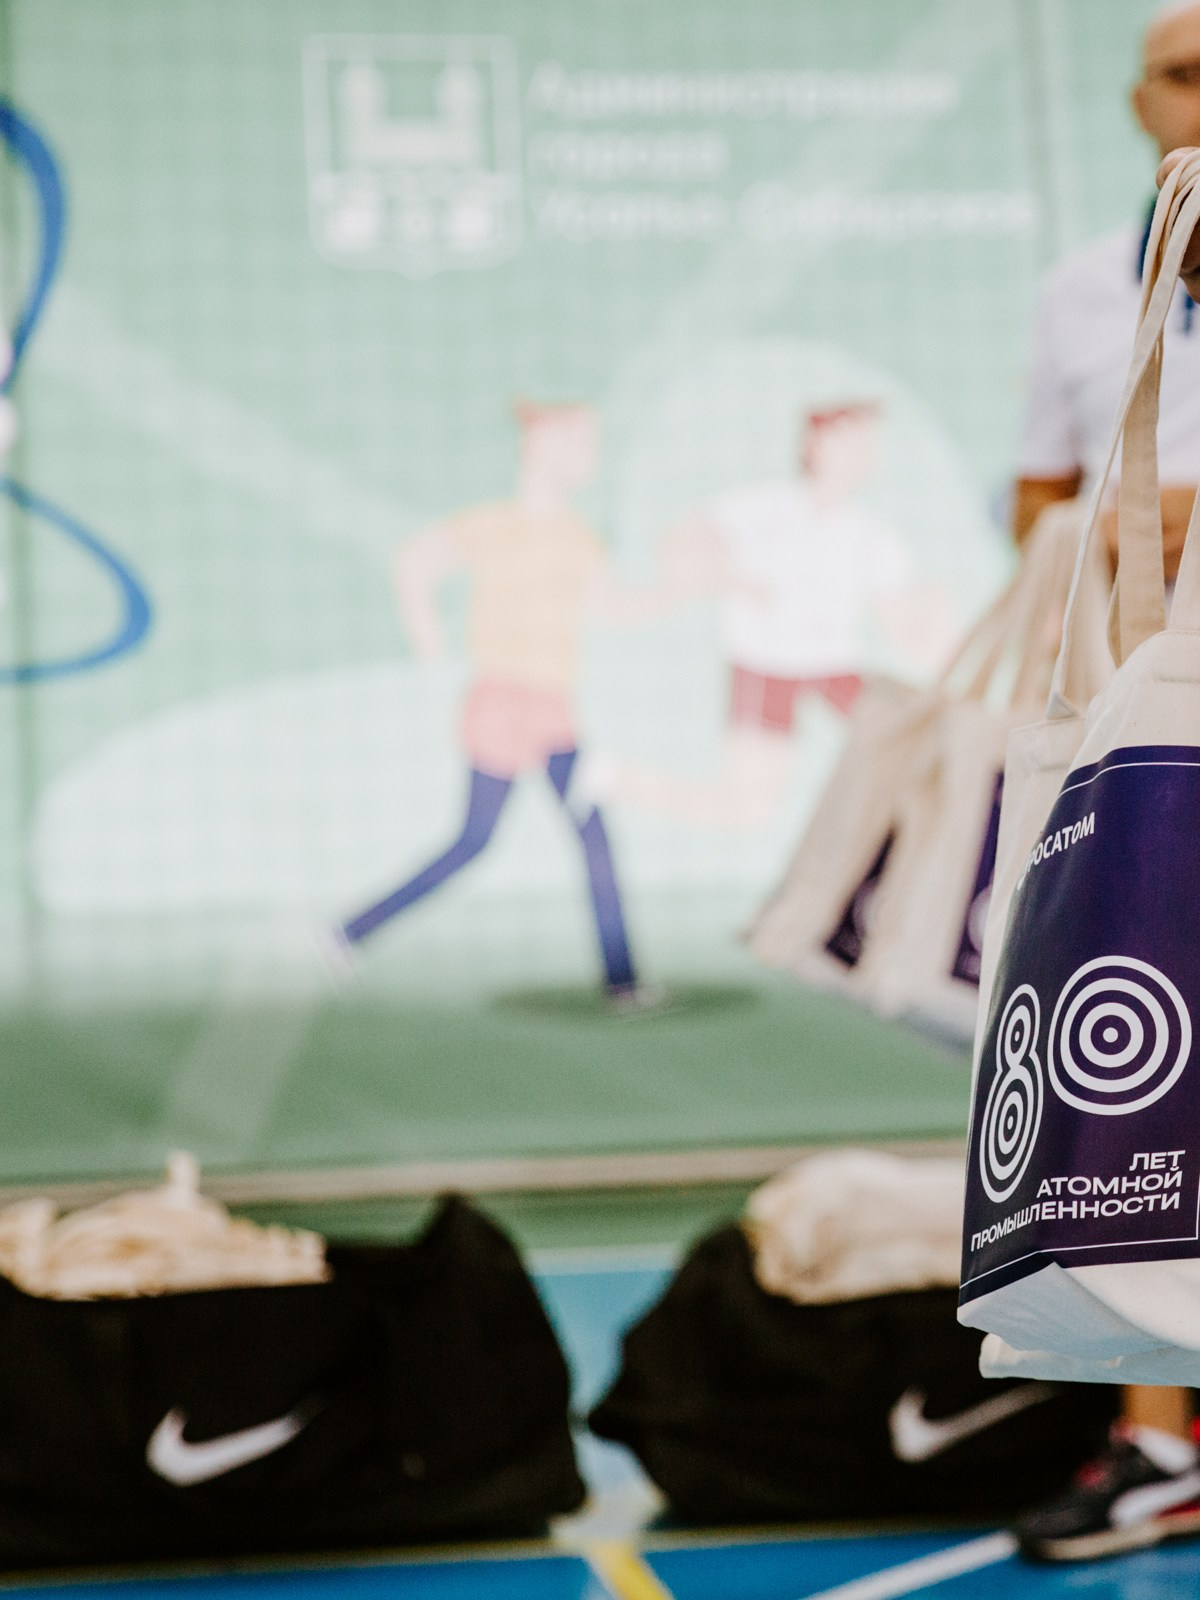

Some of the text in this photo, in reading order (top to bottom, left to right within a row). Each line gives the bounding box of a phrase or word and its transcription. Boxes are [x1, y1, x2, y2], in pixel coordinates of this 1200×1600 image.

[1129, 1150, 1186, 1171] ЛЕТ
[1036, 1166, 1183, 1198] АТОМНОЙ
[970, 1192, 1181, 1252] ПРОМЫШЛЕННОСТИ
